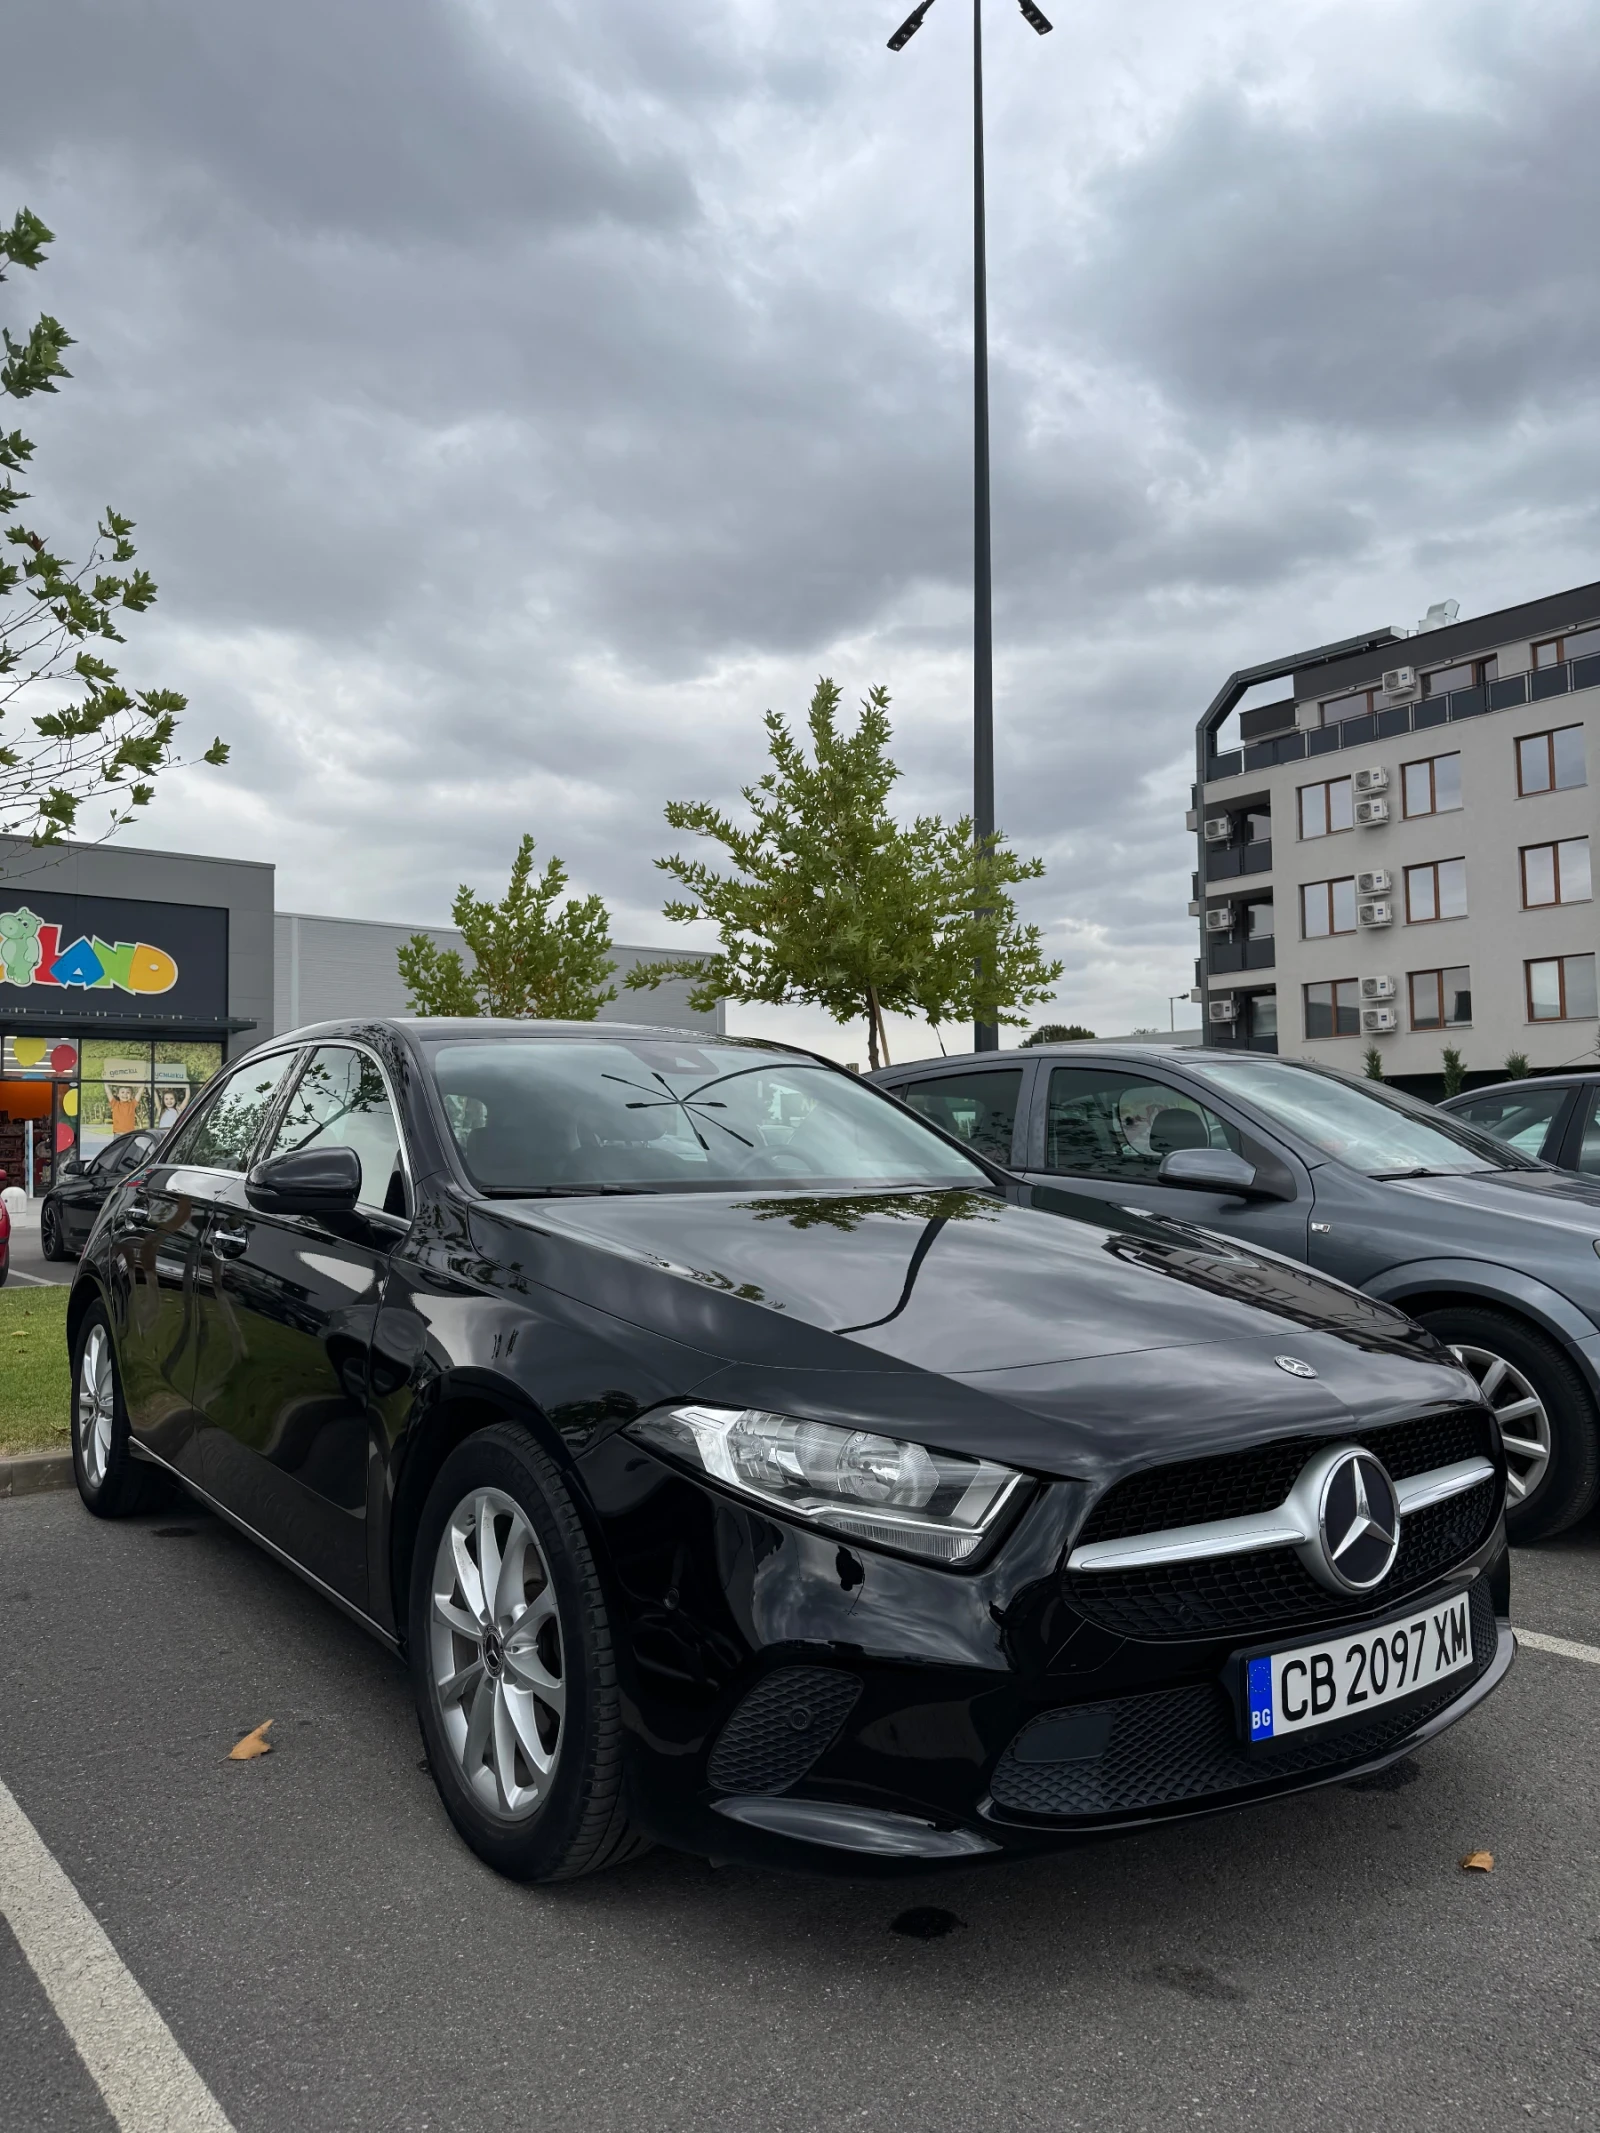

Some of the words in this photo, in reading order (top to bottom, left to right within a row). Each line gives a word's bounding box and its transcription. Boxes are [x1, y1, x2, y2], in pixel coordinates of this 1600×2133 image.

[1281, 1653, 1337, 1722] CB
[1346, 1619, 1427, 1705] 2097
[1434, 1602, 1468, 1672] XM
[1251, 1708, 1271, 1730] BG
